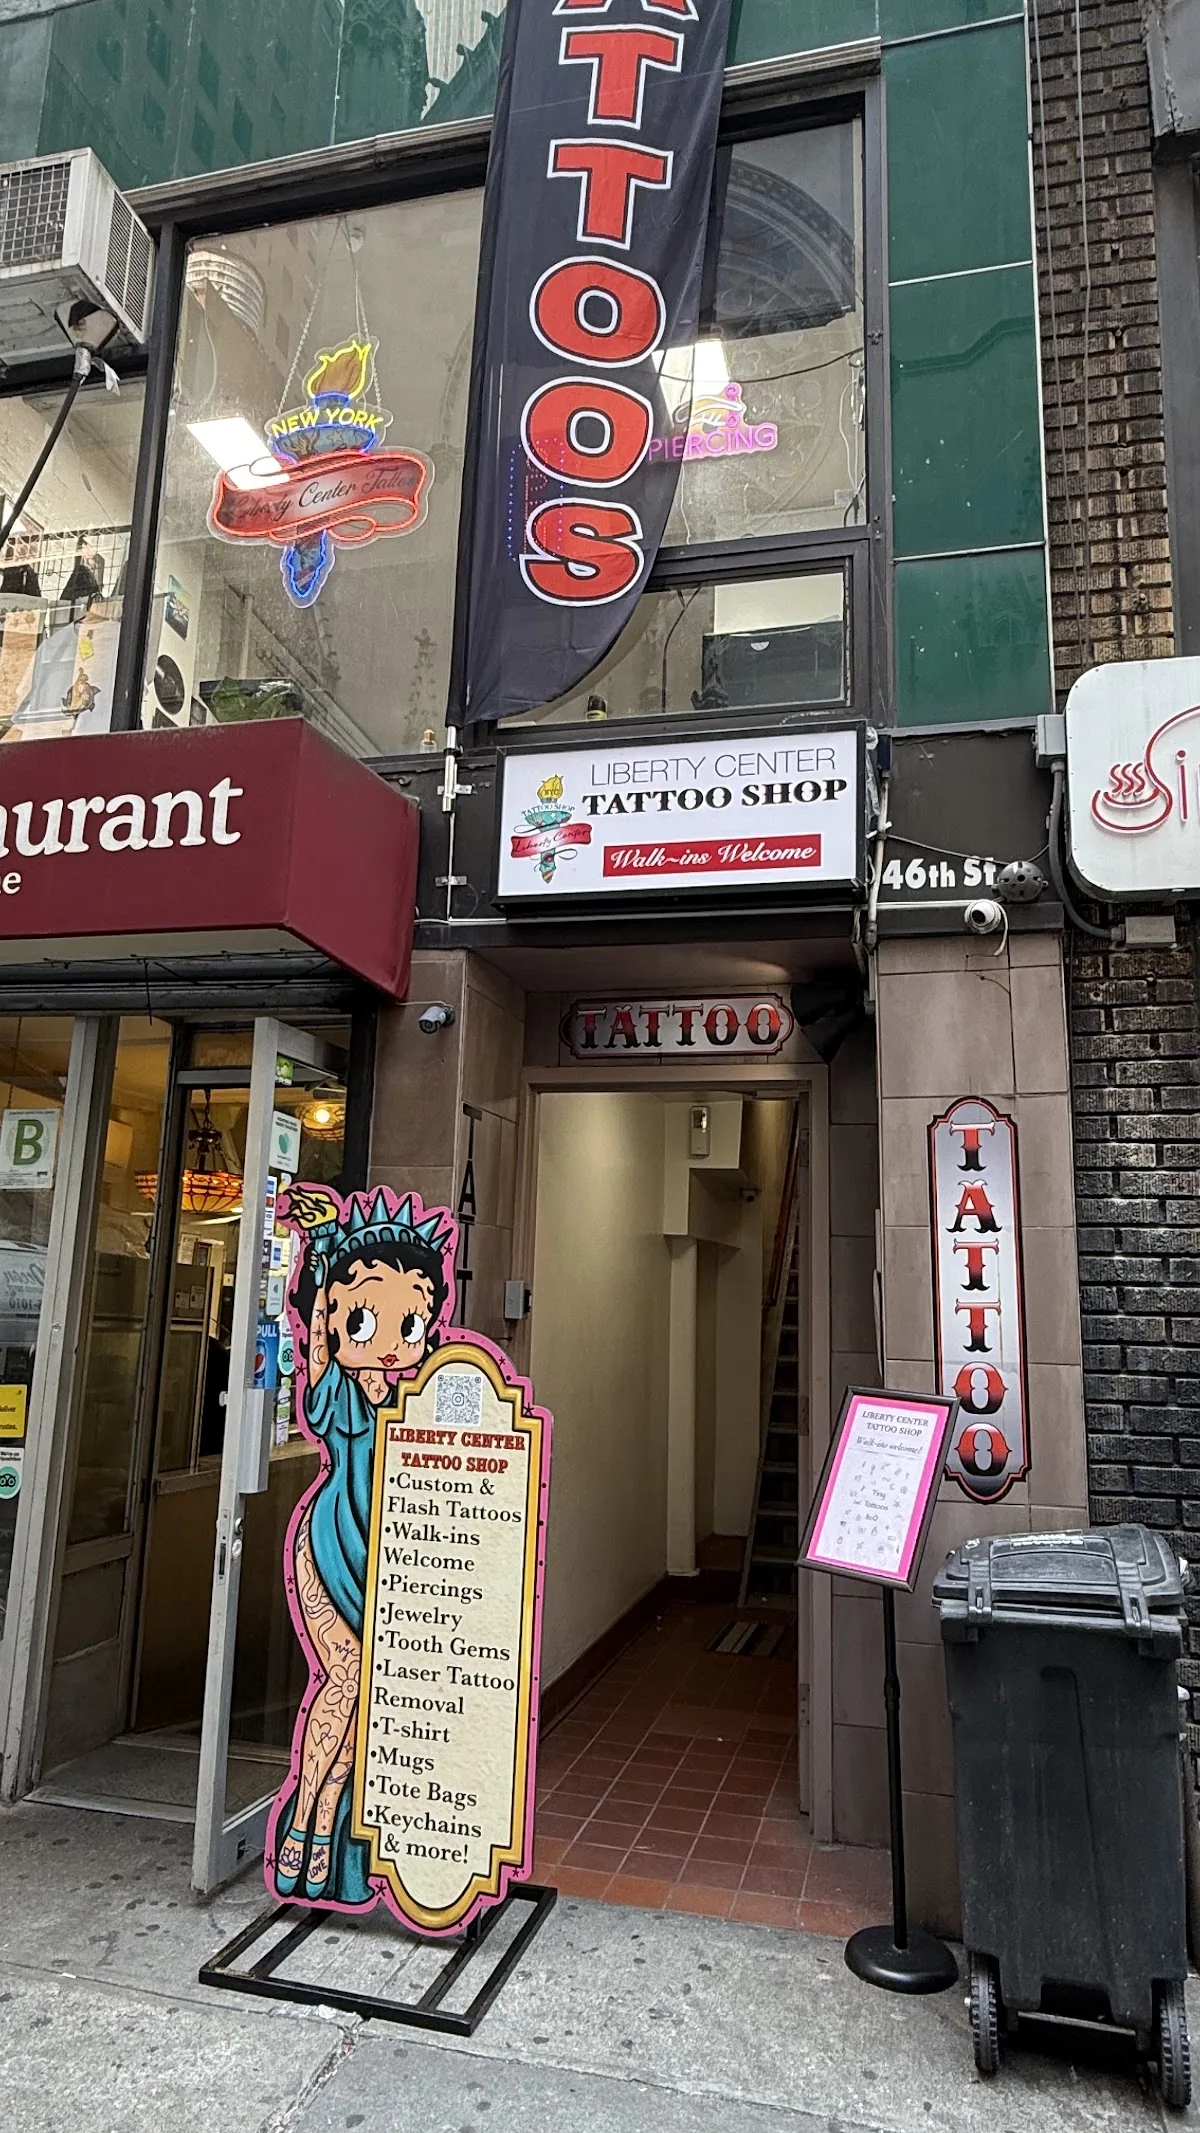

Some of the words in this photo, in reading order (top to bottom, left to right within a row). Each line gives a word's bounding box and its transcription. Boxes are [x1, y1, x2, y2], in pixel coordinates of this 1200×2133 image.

[520, 0, 699, 607] TTOOS
[271, 408, 320, 437] NEW
[325, 407, 384, 431] YORK
[648, 425, 776, 462] PIERCING
[298, 481, 357, 507] Center
[361, 467, 417, 494] Tattoo
[591, 757, 706, 786] LIBERTY
[714, 748, 836, 778] CENTER
[521, 804, 553, 817] TATTOO
[553, 803, 576, 812] SHOP
[582, 787, 732, 817] TATTOO
[741, 778, 848, 807] SHOP
[516, 837, 552, 853] Liberty
[553, 829, 588, 842] Center
[717, 842, 817, 863] Welcome
[882, 858, 956, 890] 46th
[574, 1002, 782, 1050] TATTOO
[13, 1119, 44, 1166] B
[945, 1121, 1013, 1477] TATTOO
[862, 1411, 895, 1422] LIBERTY
[896, 1415, 929, 1427] CENTER
[866, 1422, 897, 1433] TATTOO
[899, 1427, 922, 1437] SHOP
[389, 1428, 457, 1447] LIBERTY
[460, 1431, 526, 1450] CENTER
[401, 1452, 462, 1471] TATTOO
[466, 1456, 509, 1474] SHOP
[396, 1473, 473, 1494] Custom
[479, 1478, 496, 1496] &
[387, 1496, 440, 1516] Flash
[446, 1500, 522, 1523] Tattoos
[391, 1521, 481, 1546] Walk-ins
[384, 1547, 475, 1571] Welcome
[388, 1574, 483, 1604] Piercings
[382, 1602, 463, 1632] Jewelry
[385, 1630, 443, 1653] Tooth
[449, 1637, 511, 1661] Gems
[383, 1659, 441, 1682] Laser
[447, 1665, 515, 1691] Tattoo
[374, 1687, 465, 1714] Removal
[379, 1716, 450, 1743] T-shirt
[377, 1746, 435, 1774] Mugs
[376, 1775, 421, 1798] Tote
[427, 1782, 478, 1811] Bags
[374, 1805, 482, 1838] Keychains
[312, 1846, 326, 1861] ONE
[384, 1833, 400, 1853] &
[406, 1844, 469, 1864] more!
[309, 1859, 327, 1879] LOVE
